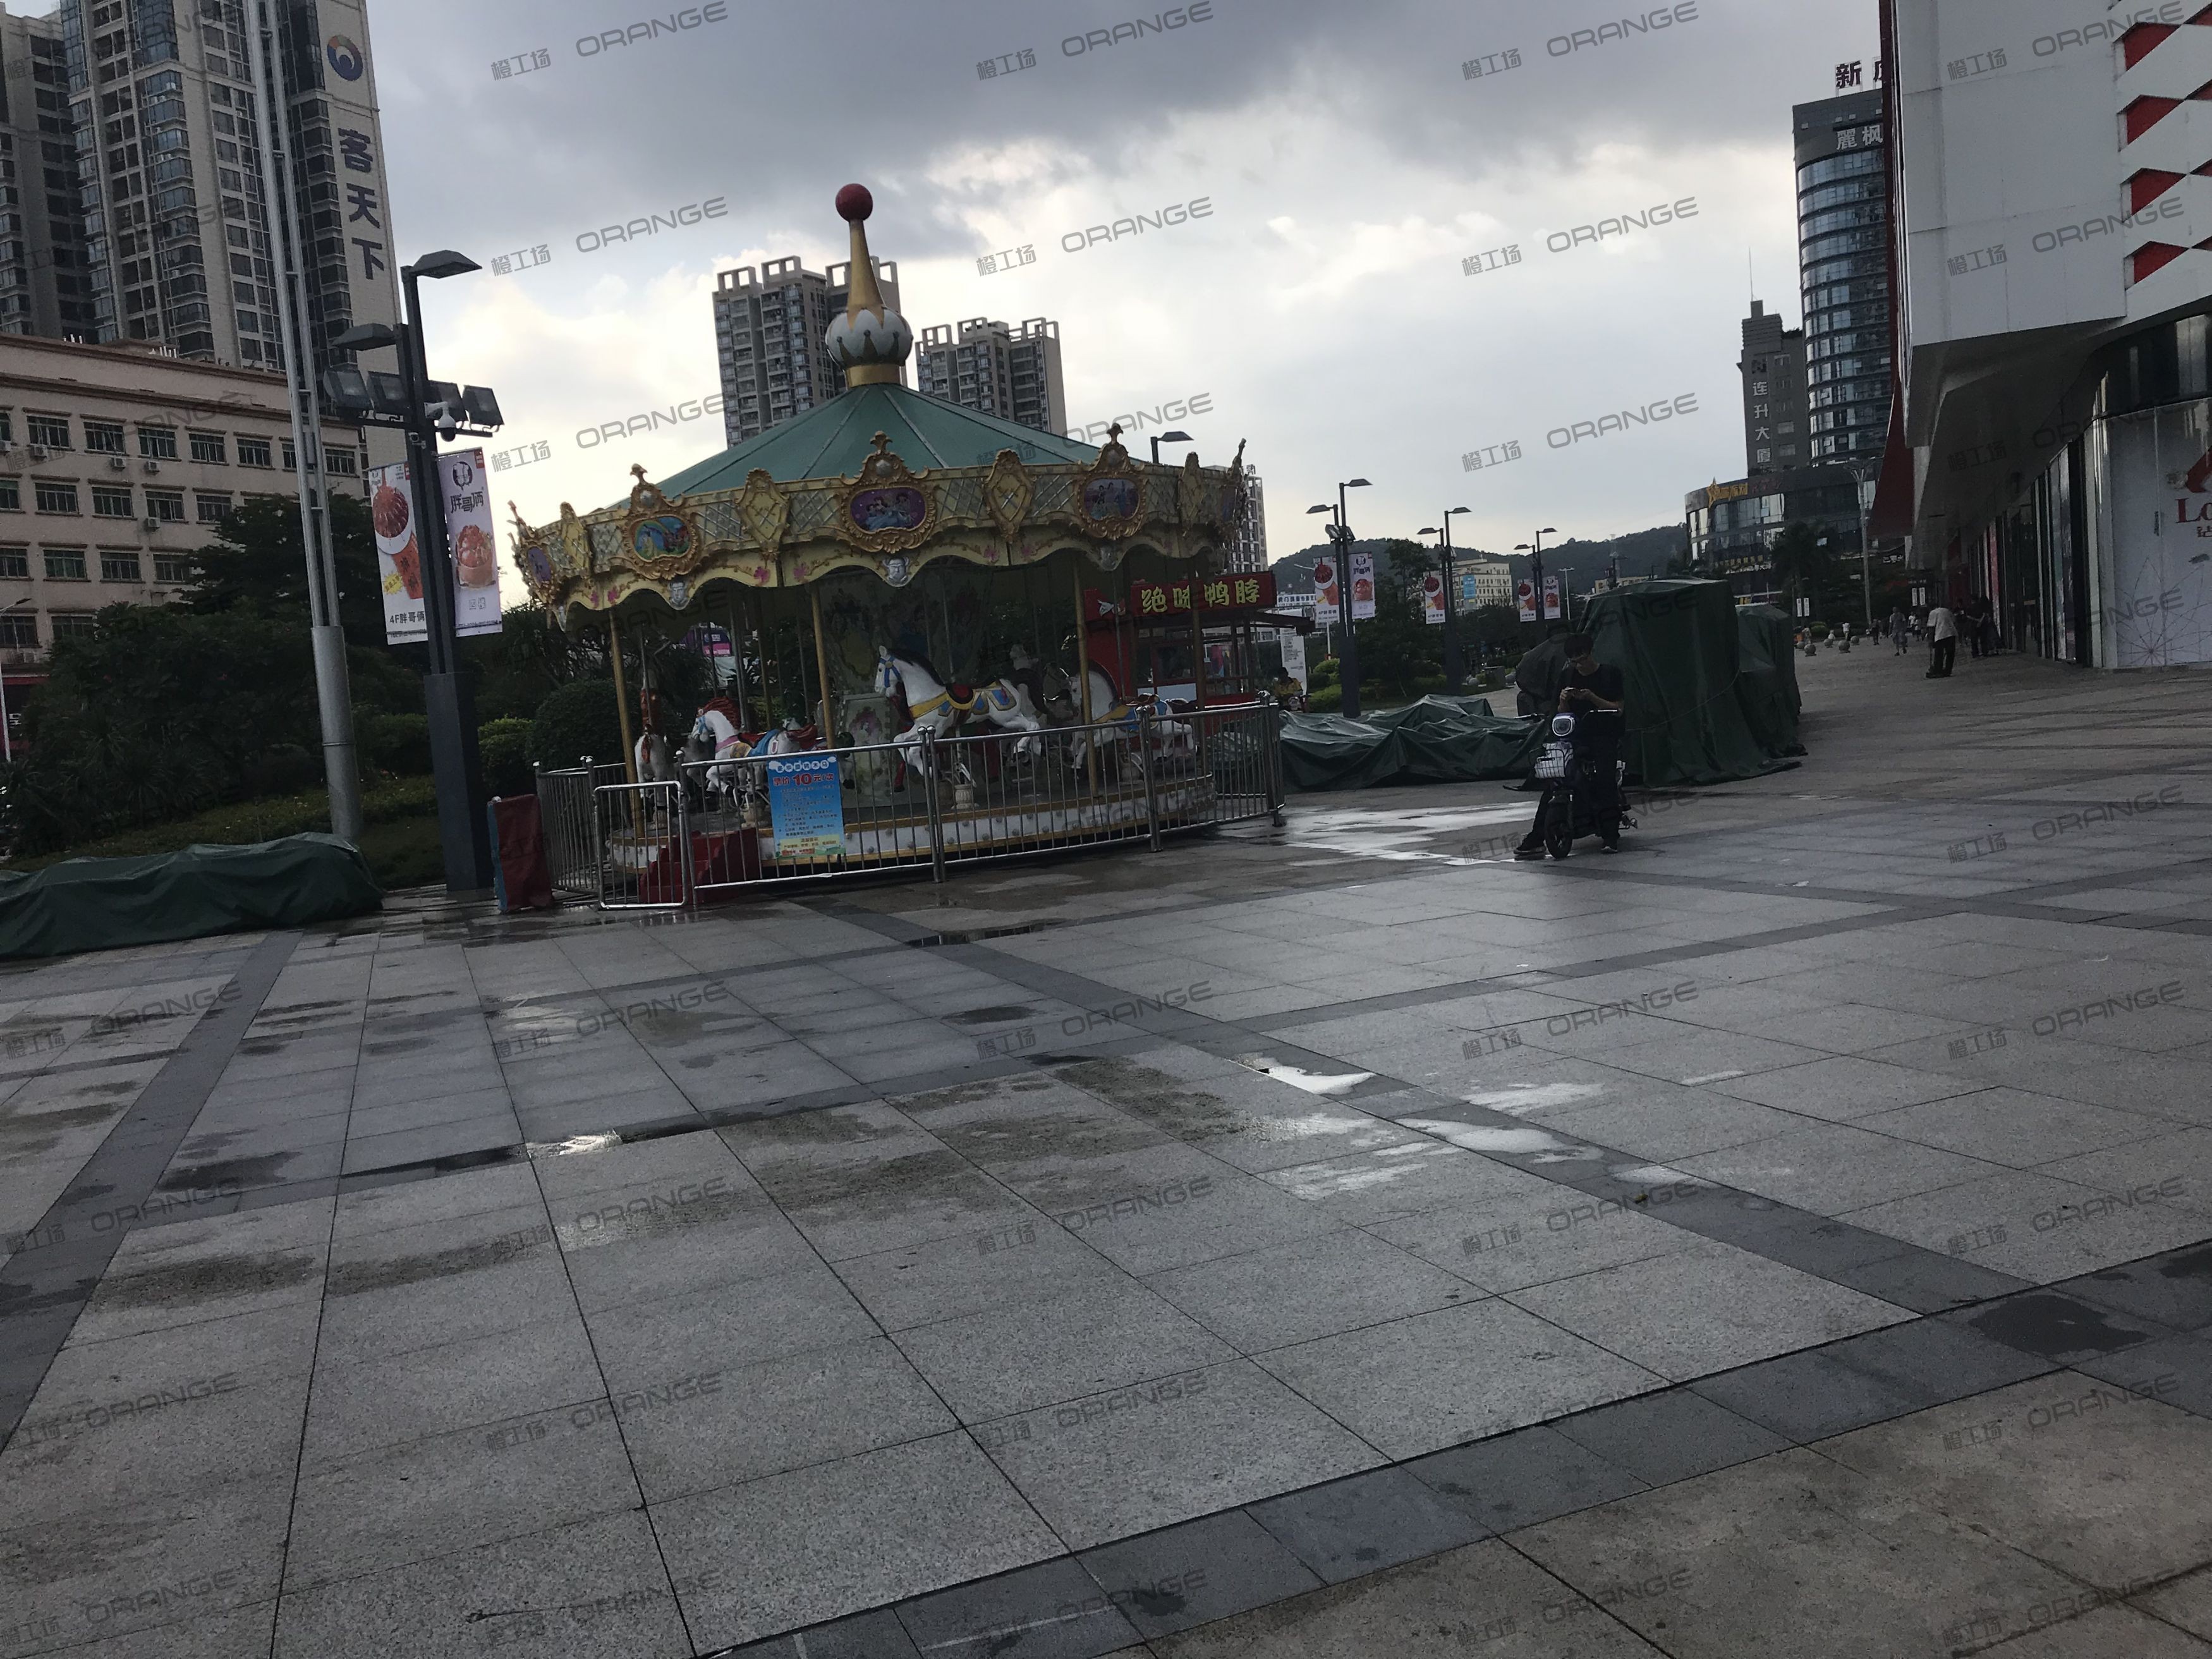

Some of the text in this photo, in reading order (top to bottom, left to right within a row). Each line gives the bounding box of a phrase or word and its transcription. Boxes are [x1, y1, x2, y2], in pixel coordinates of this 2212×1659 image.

[1836, 124, 1884, 150] 麗枫
[338, 128, 385, 280] 客天下
[1753, 381, 1771, 463] 连升大厦
[451, 491, 484, 513] 胖哥俩
[1141, 578, 1260, 613] 绝味鸭脖
[389, 611, 425, 624] 4F胖哥俩
